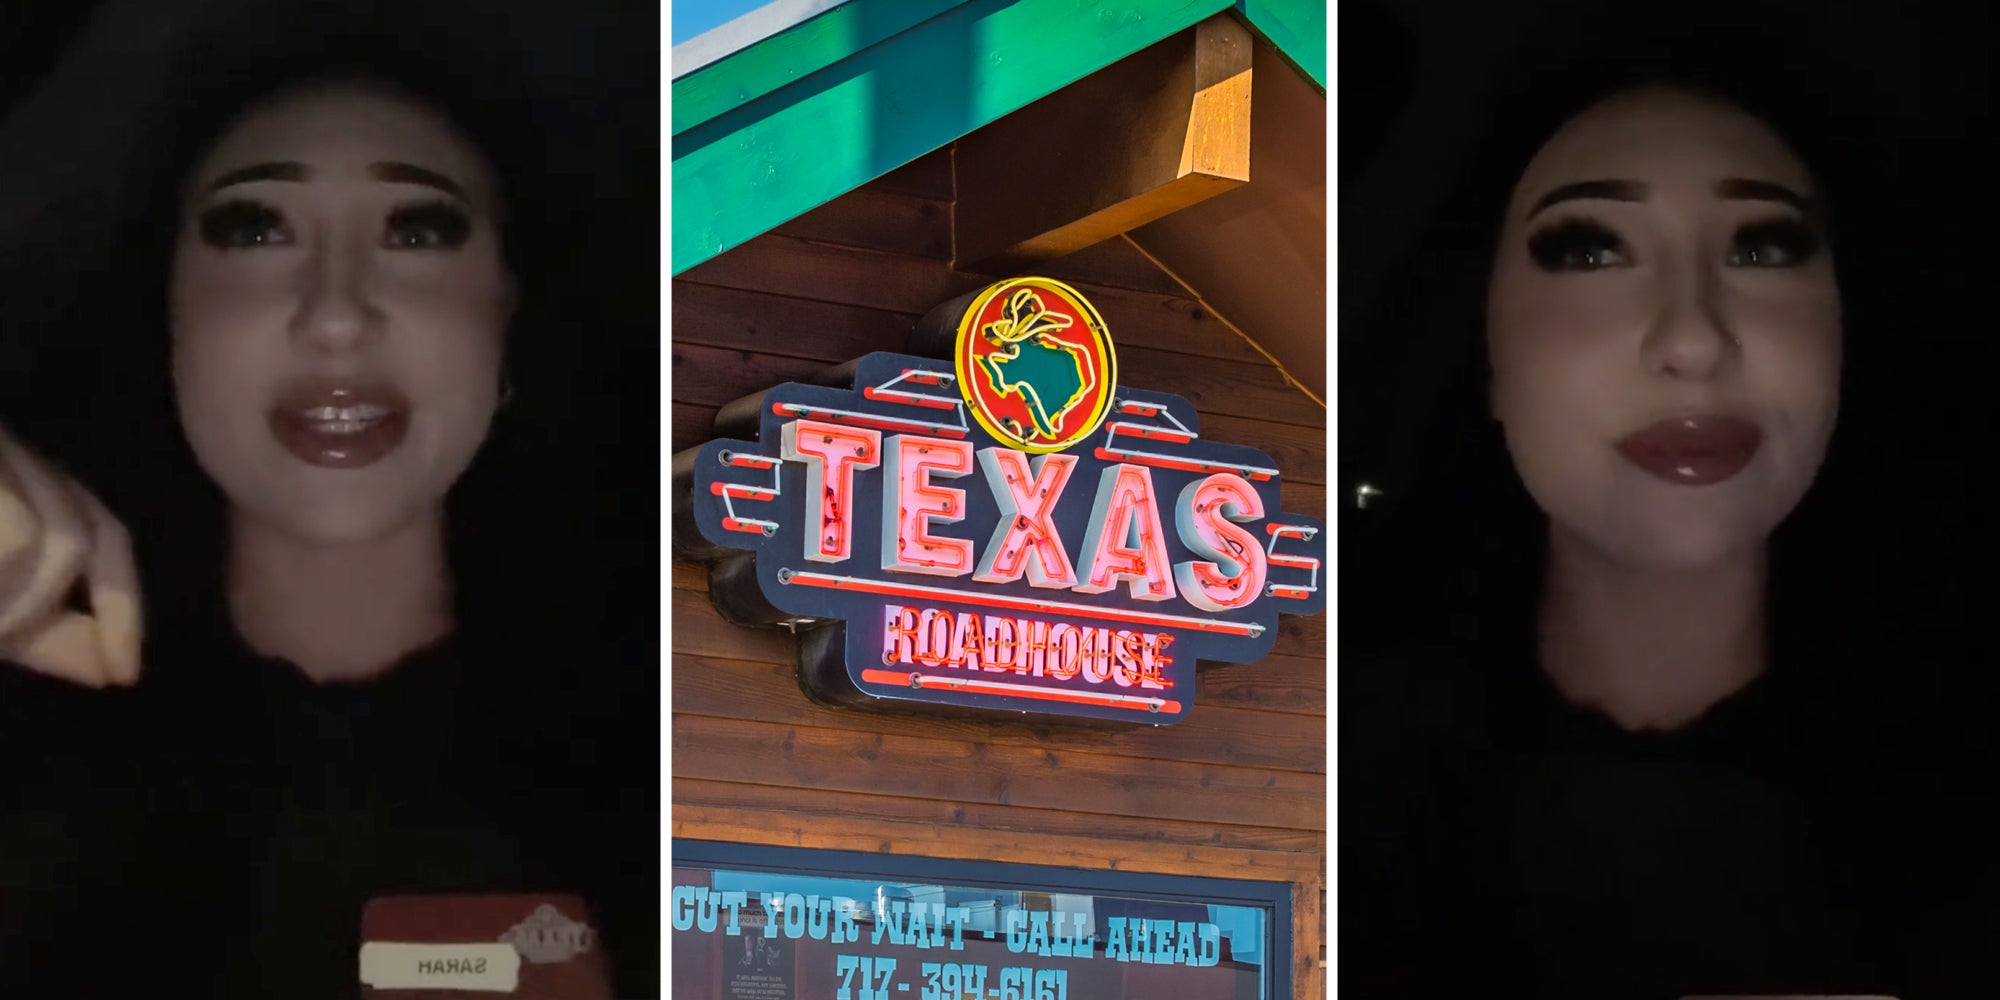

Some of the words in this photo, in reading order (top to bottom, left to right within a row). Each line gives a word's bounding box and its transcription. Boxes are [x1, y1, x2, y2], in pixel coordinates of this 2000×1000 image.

[781, 419, 1267, 612] TEXAS
[884, 604, 1175, 690] ROADHOUSE
[672, 885, 748, 935] CUT
[760, 891, 859, 944] YOUR
[871, 900, 970, 951] WAIT
[1006, 910, 1094, 959] CALL
[1105, 916, 1220, 967] AHEAD
[921, 961, 1068, 1000] 394-6161
